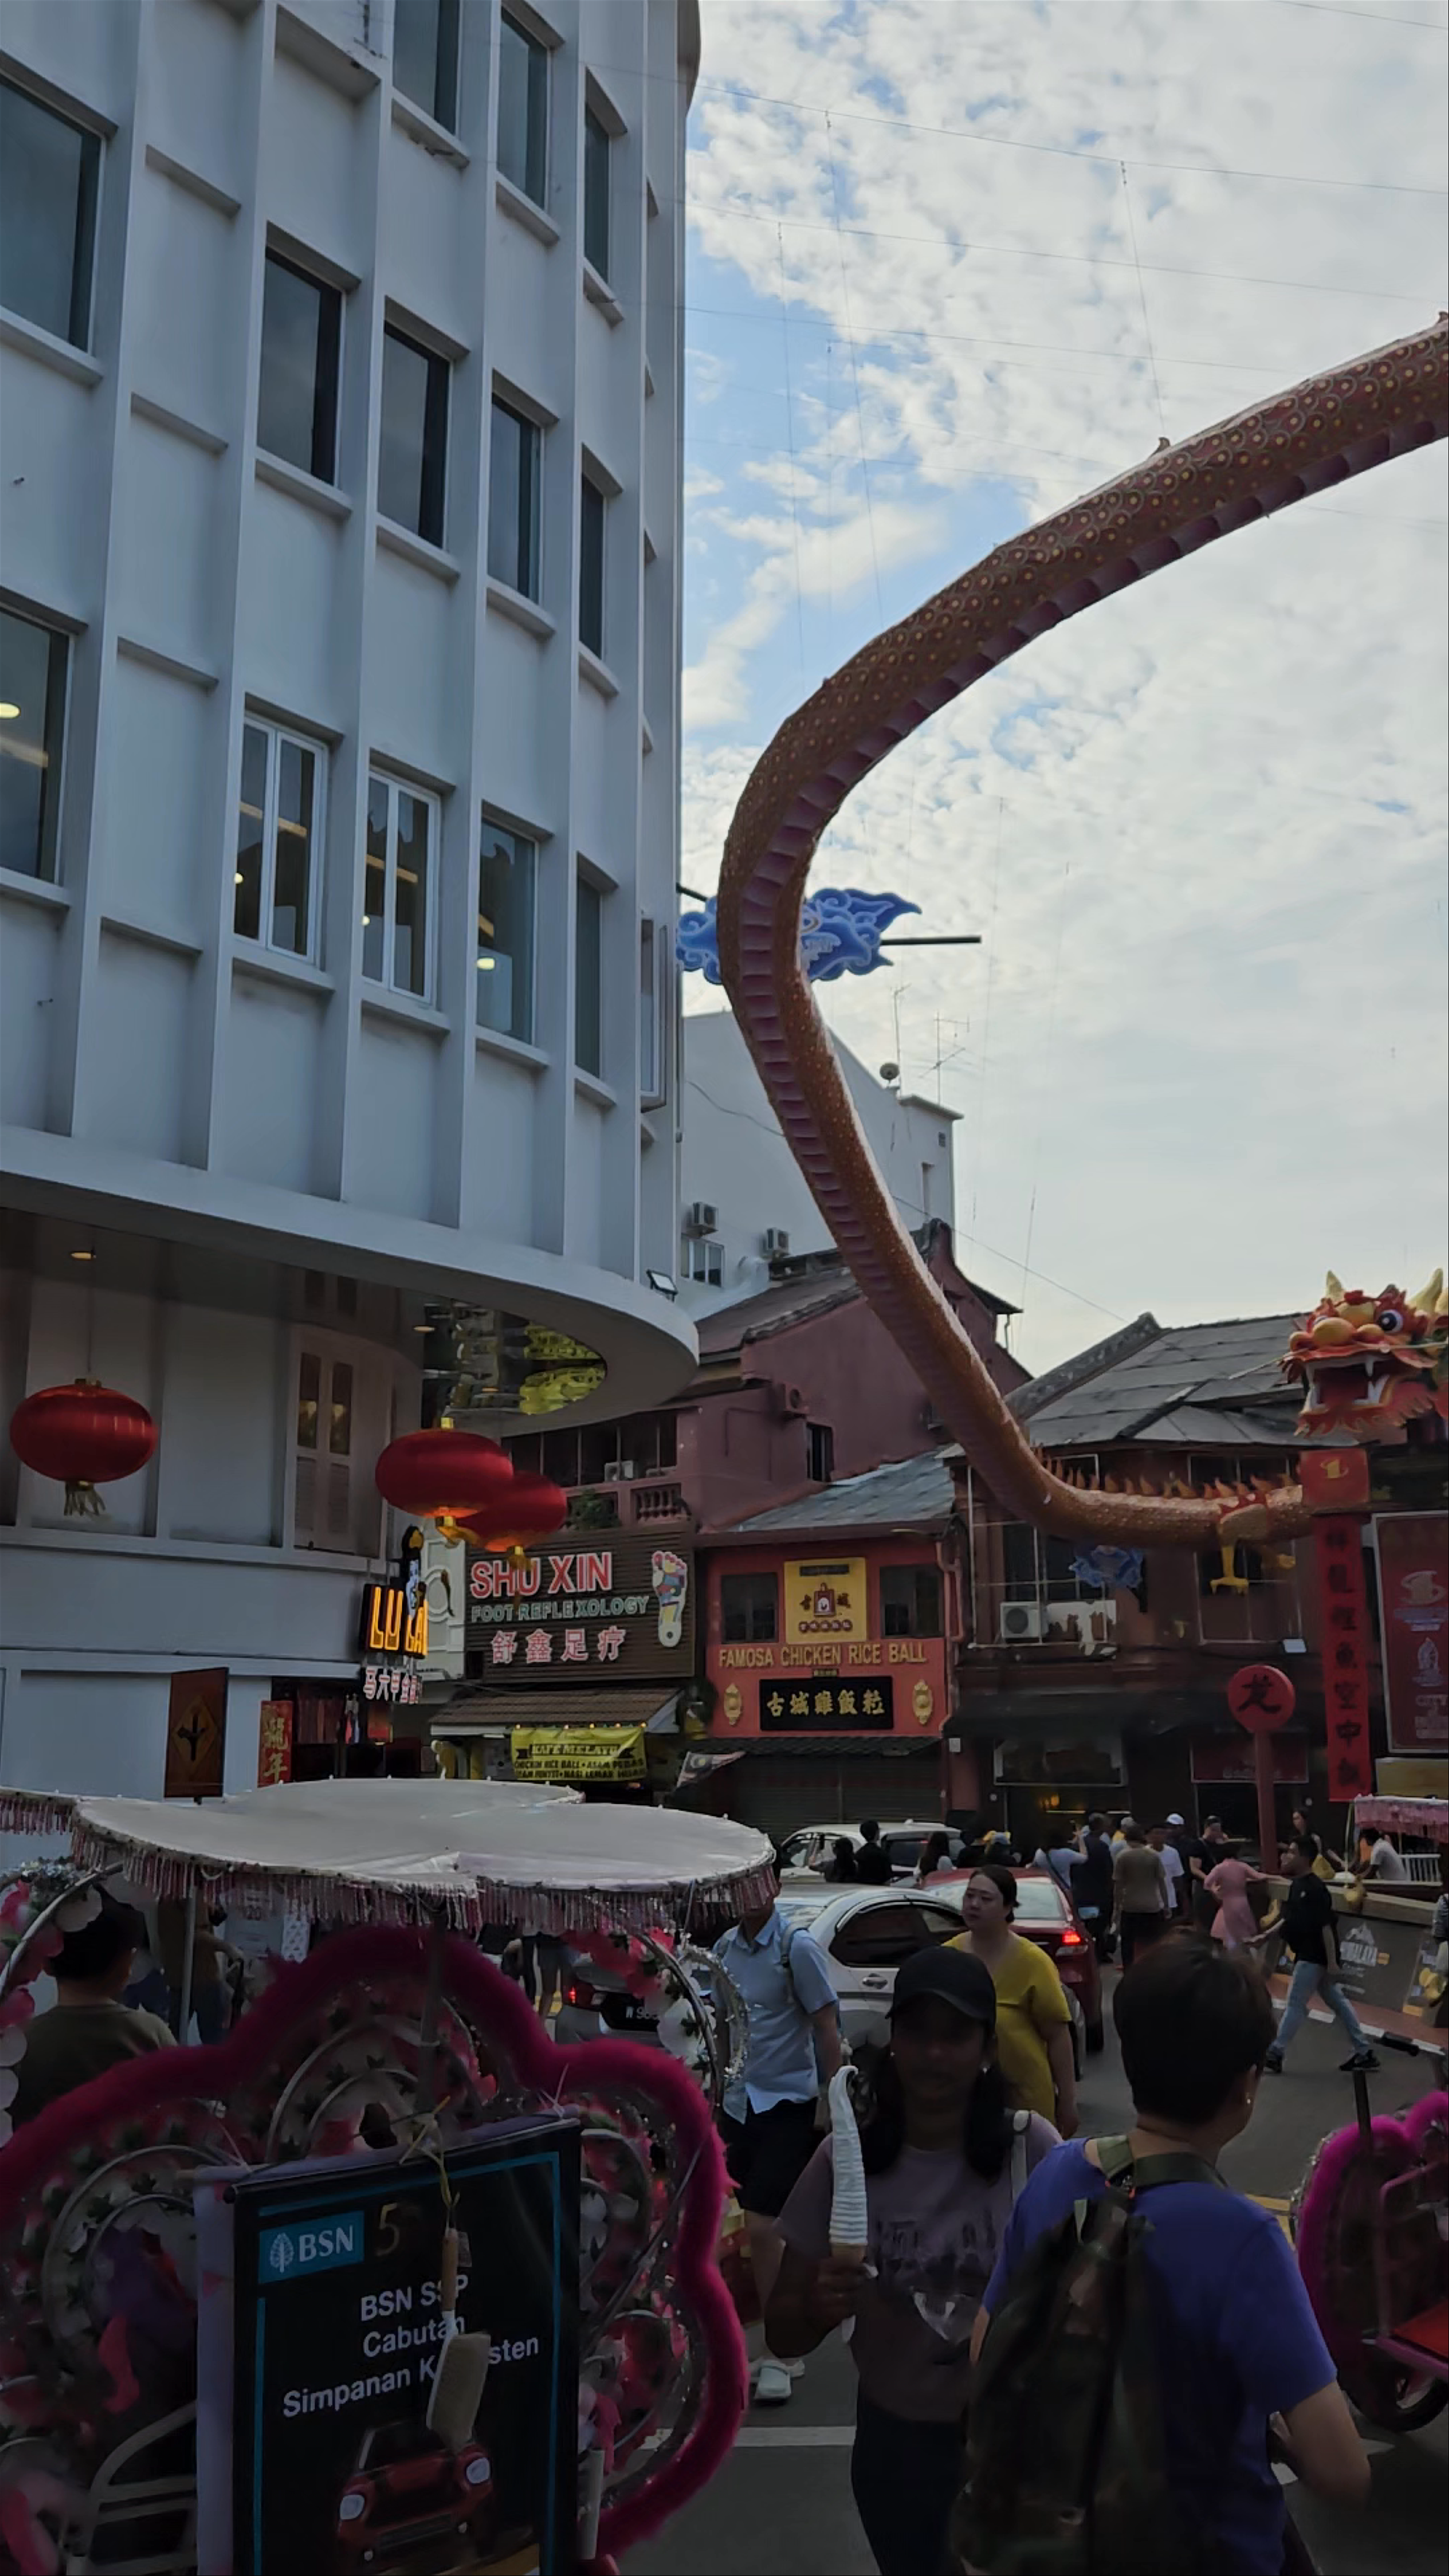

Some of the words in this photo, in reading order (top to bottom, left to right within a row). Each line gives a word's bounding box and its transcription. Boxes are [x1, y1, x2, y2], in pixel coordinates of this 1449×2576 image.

[470, 1557, 541, 1599] SHU
[548, 1552, 612, 1594] XIN
[471, 1604, 514, 1622] FOOT
[518, 1596, 649, 1621] REFLEXOLOGY
[492, 1626, 626, 1664] 舒鑫足疗
[719, 1647, 774, 1667] FAMOSA
[781, 1644, 841, 1666] CHICKEN
[849, 1644, 881, 1664] RICE
[889, 1642, 926, 1663] BALL
[299, 2225, 354, 2262] BSN
[360, 2286, 412, 2322] BSN
[420, 2274, 469, 2306] SP
[283, 2367, 411, 2418] Simpanan
